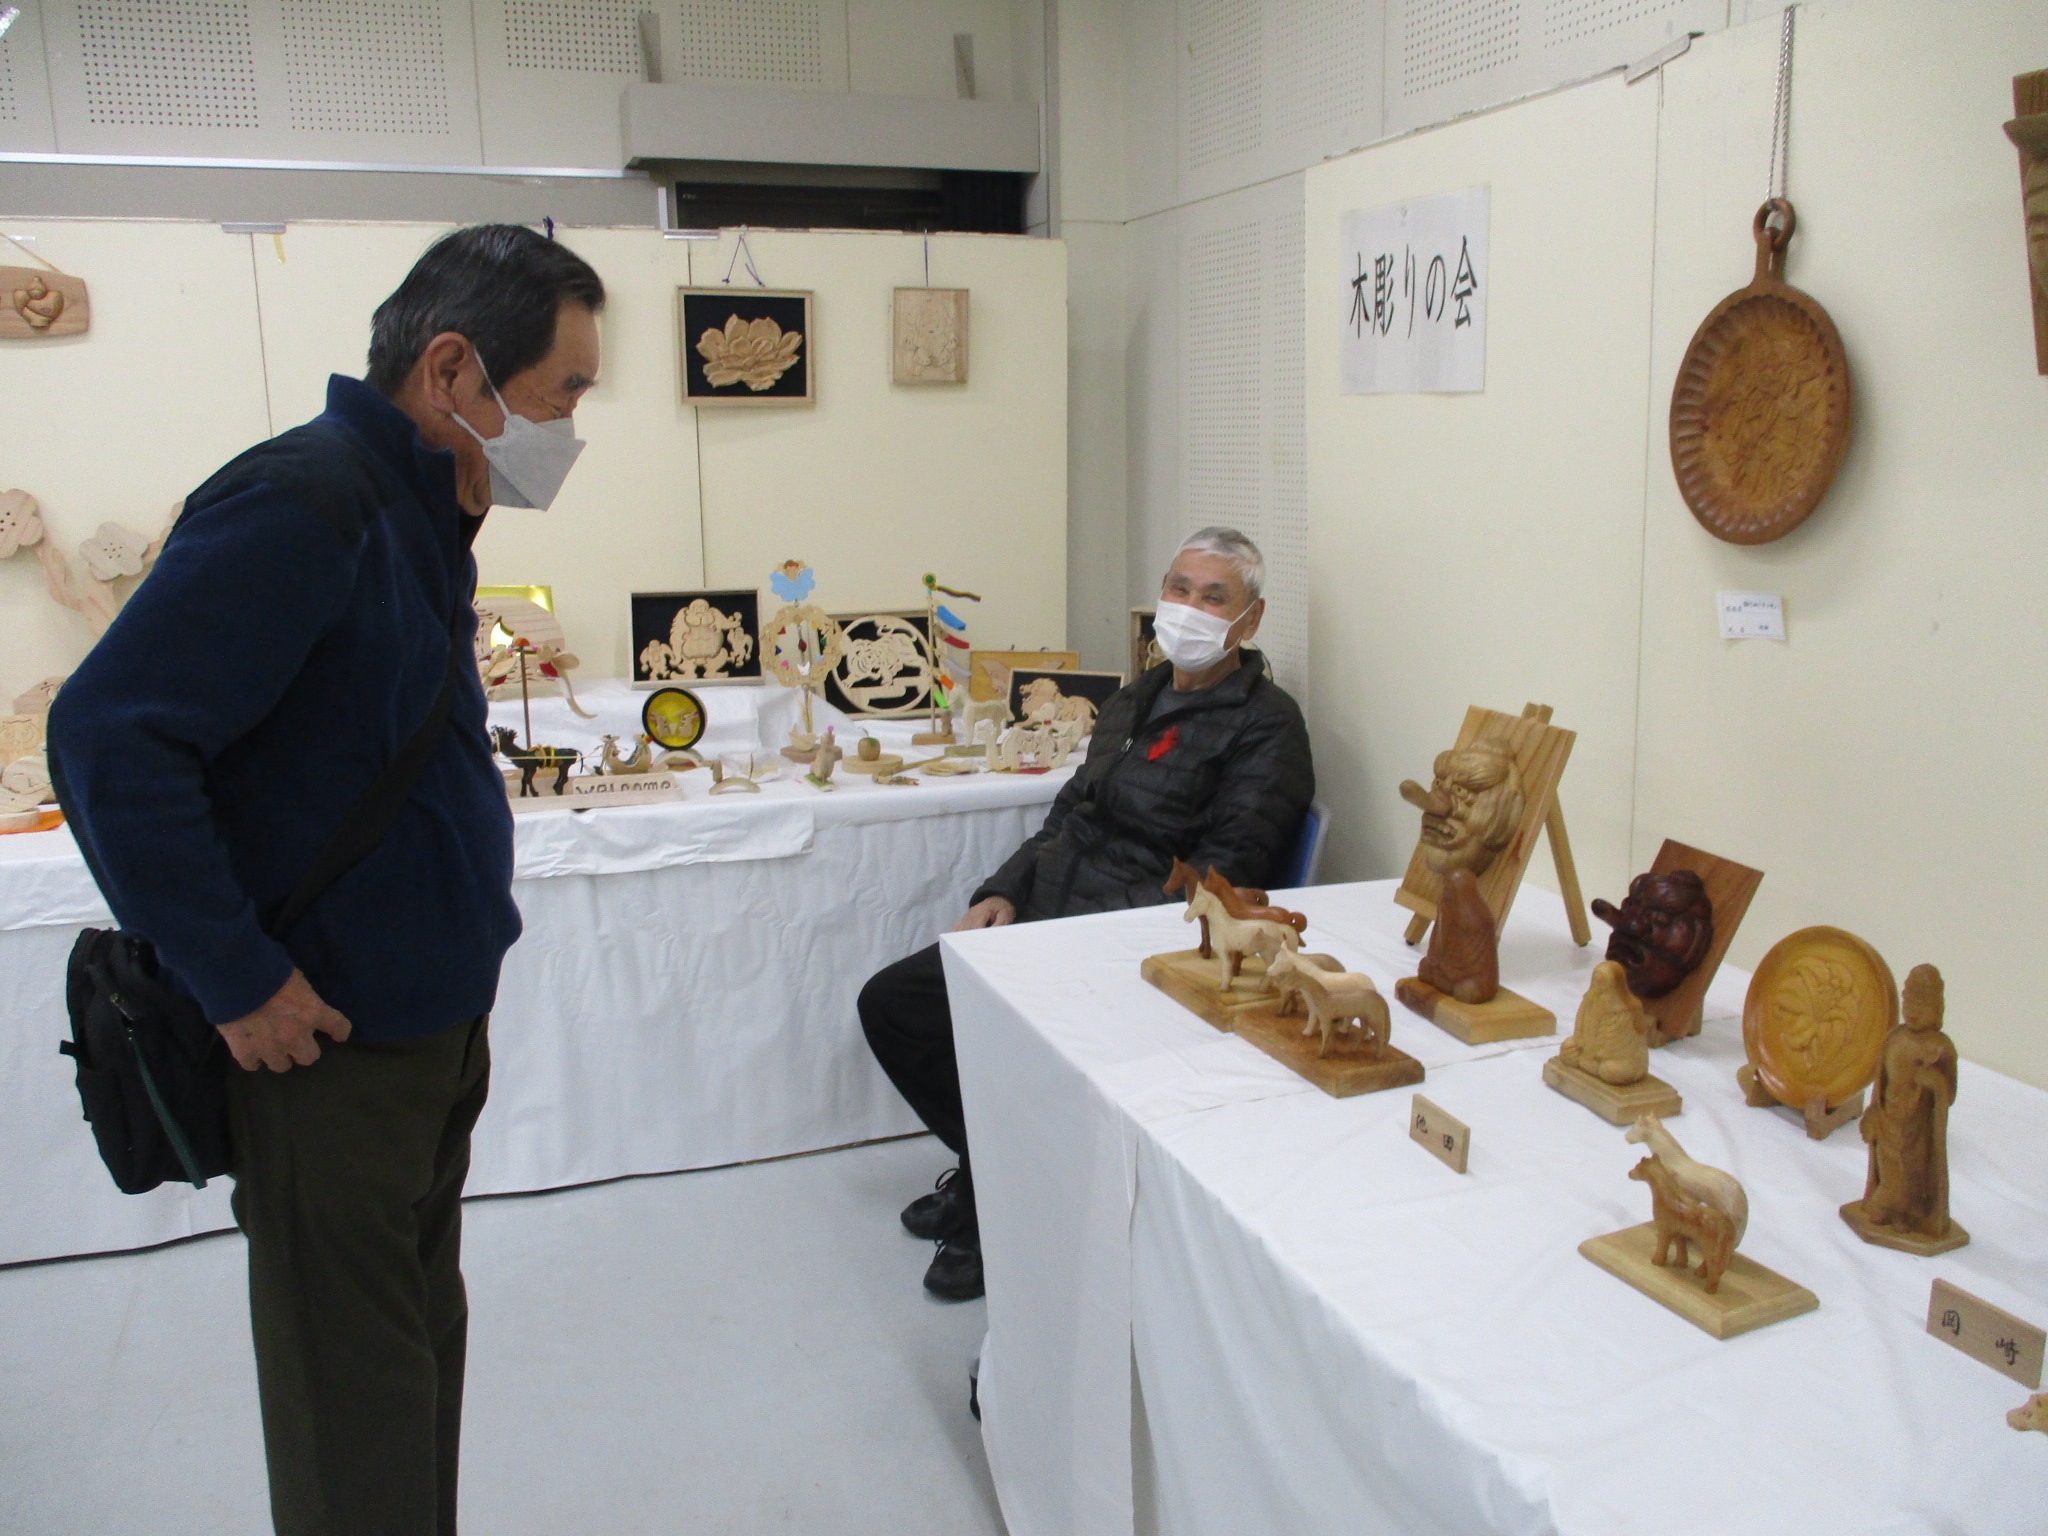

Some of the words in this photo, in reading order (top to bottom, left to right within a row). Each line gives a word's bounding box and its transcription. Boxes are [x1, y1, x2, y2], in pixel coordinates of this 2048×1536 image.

[1349, 235, 1478, 340] 木彫りの会
